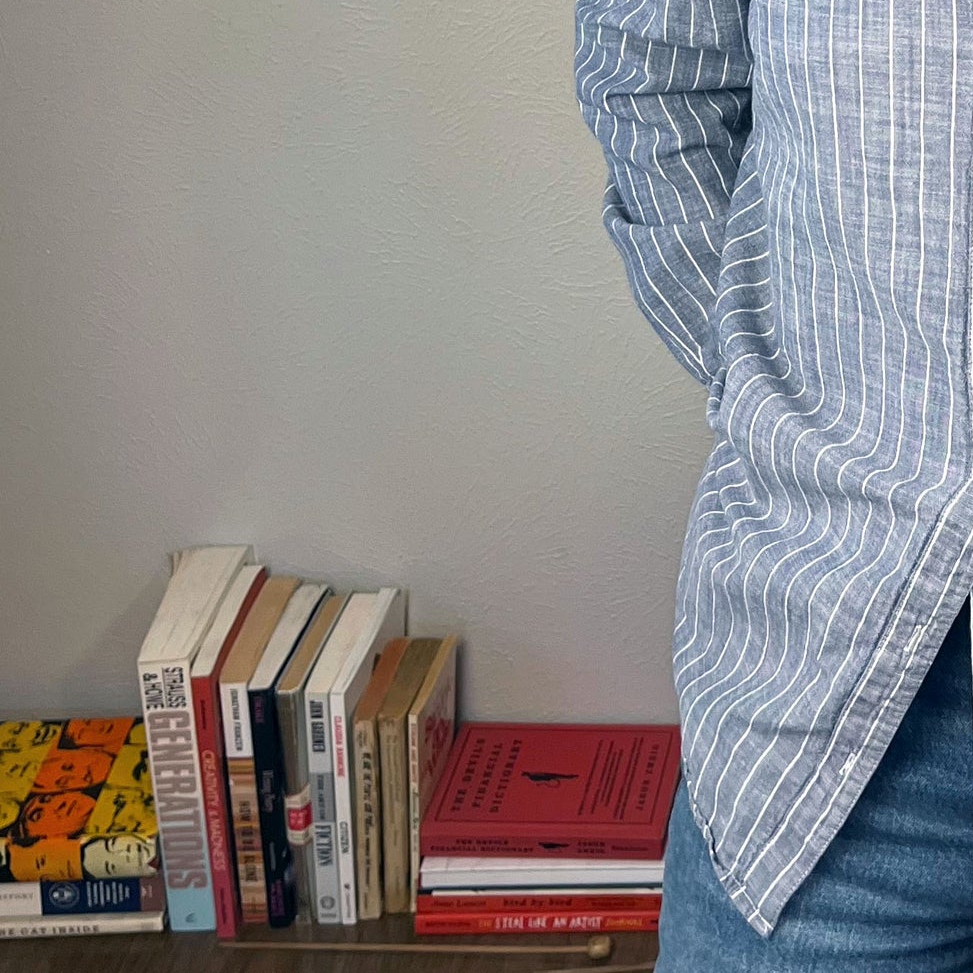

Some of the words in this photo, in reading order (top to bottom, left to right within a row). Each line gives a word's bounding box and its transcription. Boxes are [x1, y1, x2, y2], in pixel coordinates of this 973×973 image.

[142, 672, 158, 682] &
[165, 666, 187, 708] STRAUSS
[143, 682, 165, 710] HOWE
[471, 742, 503, 808] FINANCIAL
[489, 739, 522, 813] DICTIONARY
[147, 710, 208, 889] GENERATIONS
[201, 749, 219, 807] CREATIVITY
[210, 818, 226, 871] MADNESS
[239, 801, 252, 822] HOW
[449, 788, 466, 812] THE
[315, 824, 333, 867] FICTION
[340, 821, 350, 854] CITIZEN
[20, 926, 47, 936] CAT
[52, 924, 99, 935] INSIDE
[495, 915, 524, 929] STEAL
[528, 916, 547, 928] LIKE
[552, 916, 568, 928] AN
[569, 915, 603, 928] ARTIST
